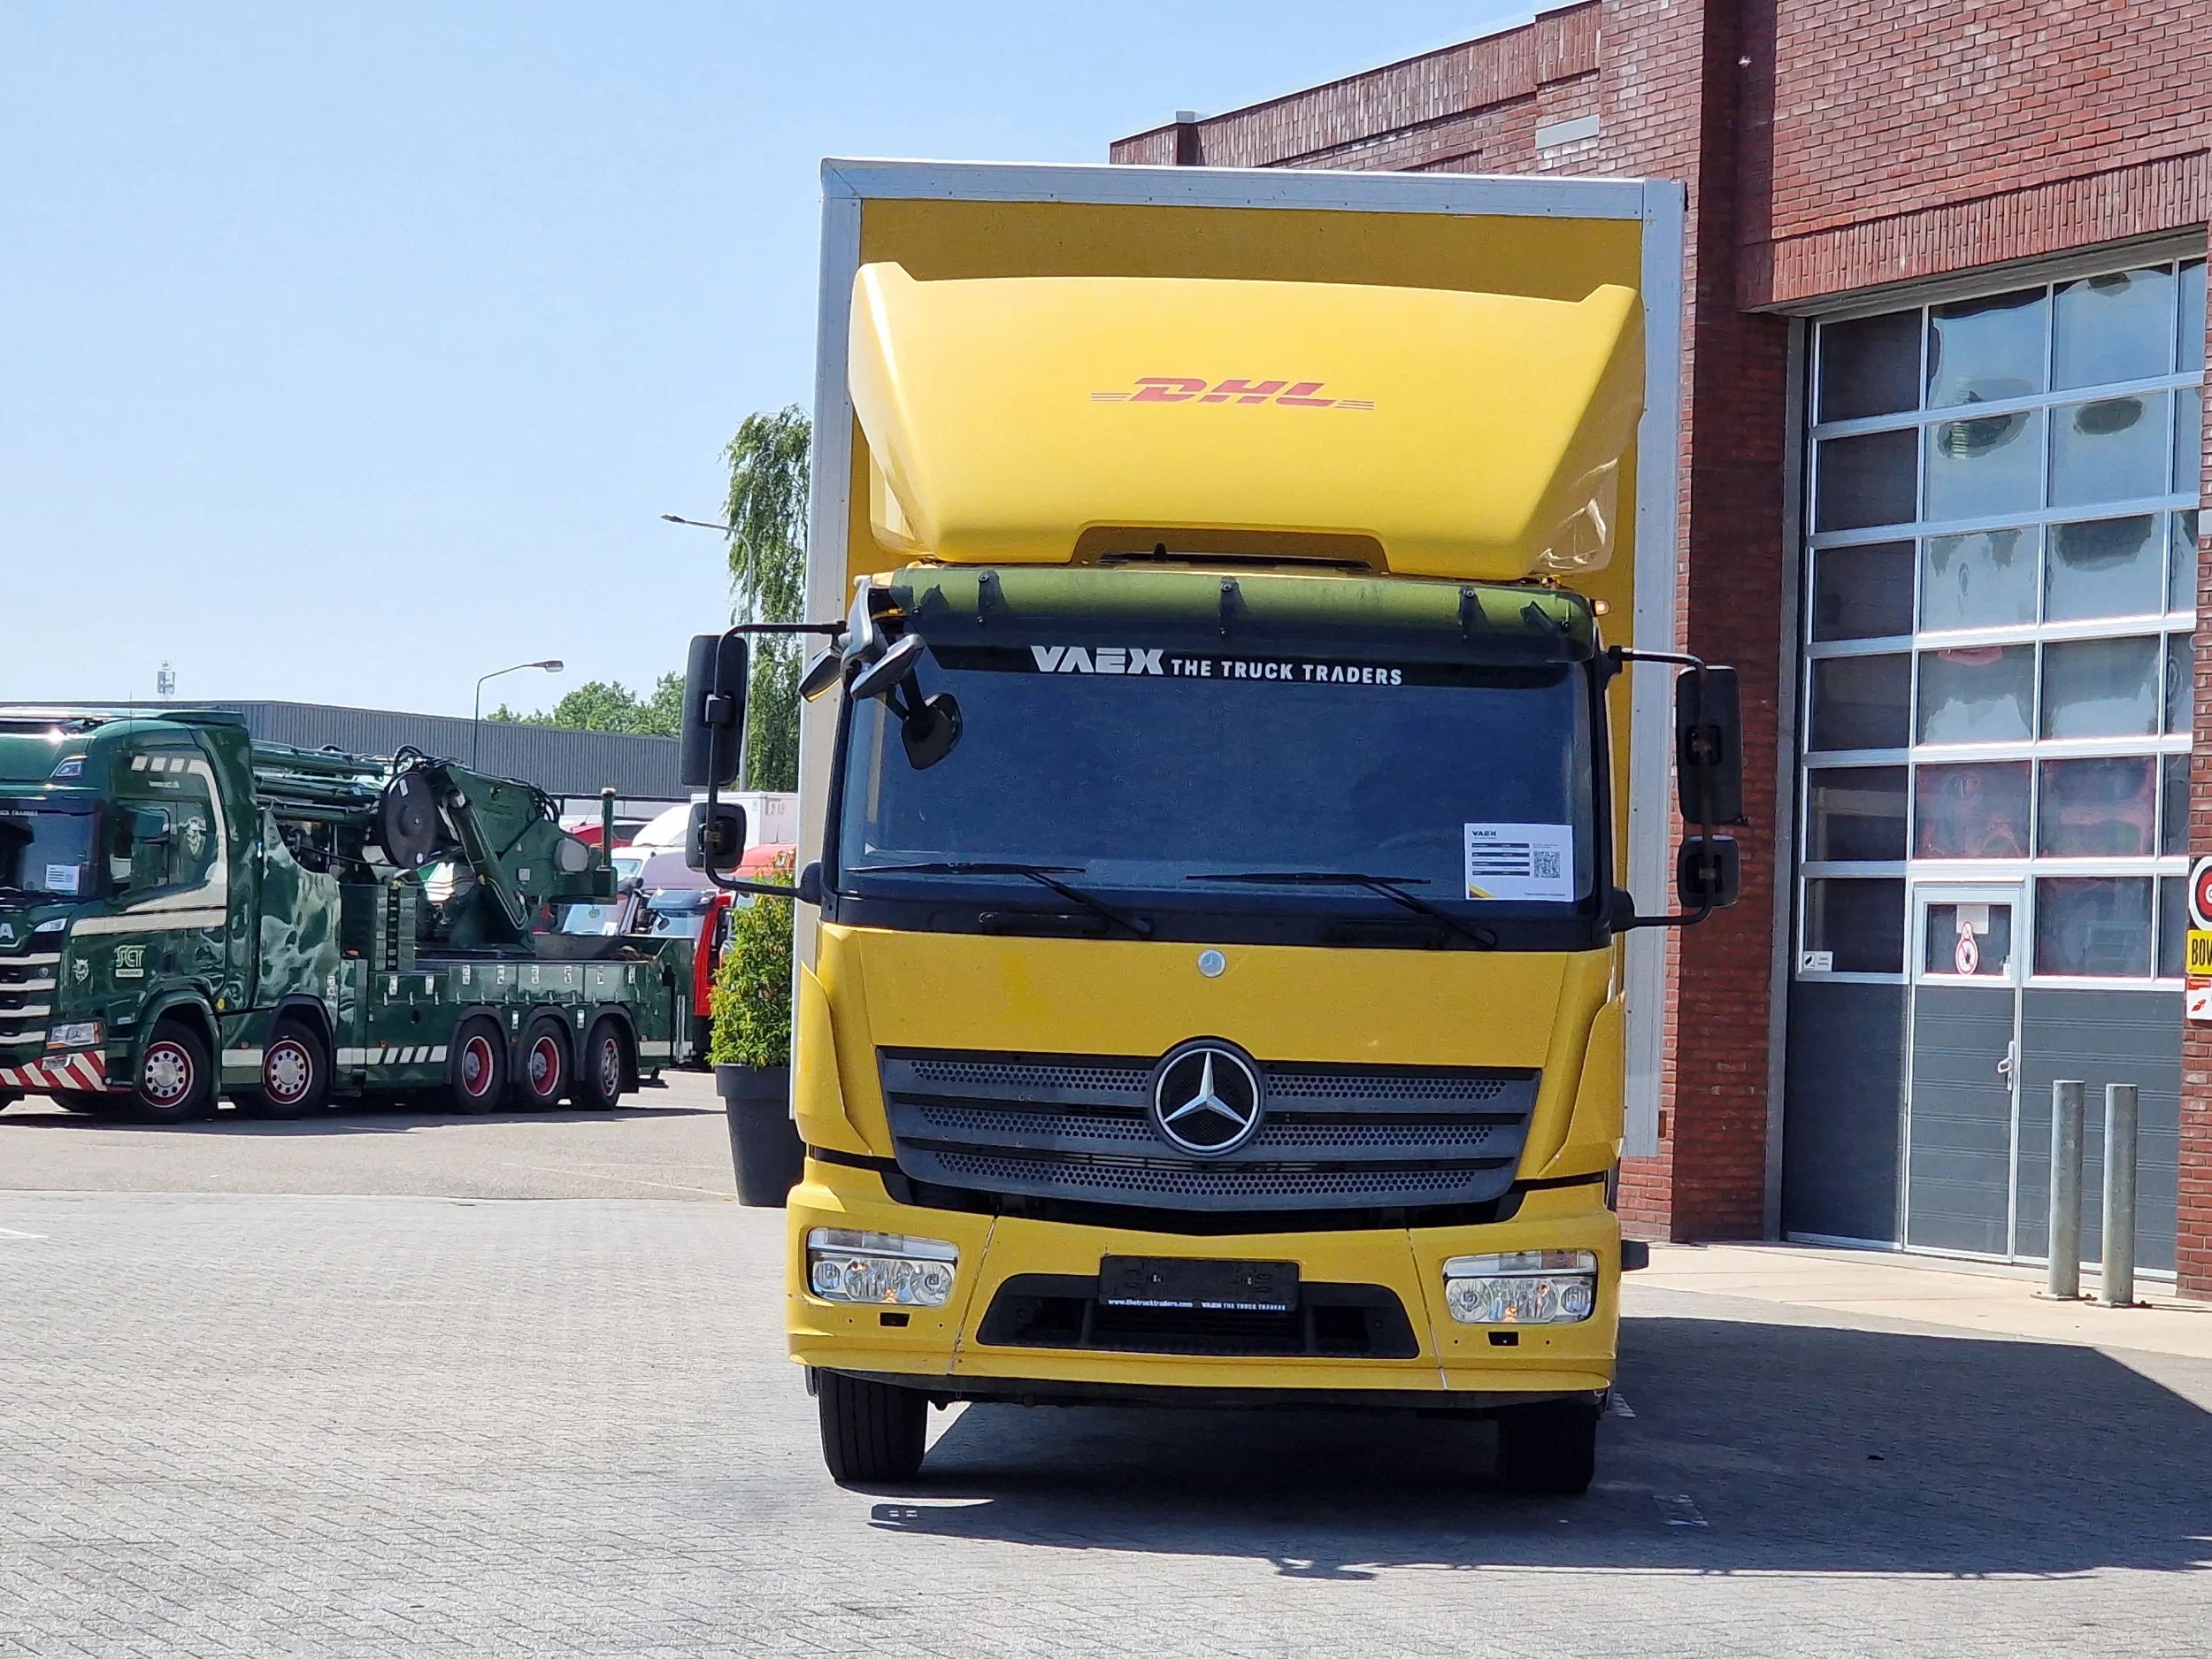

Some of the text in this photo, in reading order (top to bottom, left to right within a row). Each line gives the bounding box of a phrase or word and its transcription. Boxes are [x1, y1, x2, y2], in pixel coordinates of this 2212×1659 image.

[1128, 376, 1338, 408] DHL
[1030, 645, 1402, 686] VAEX THE TRUCK TRADERS
